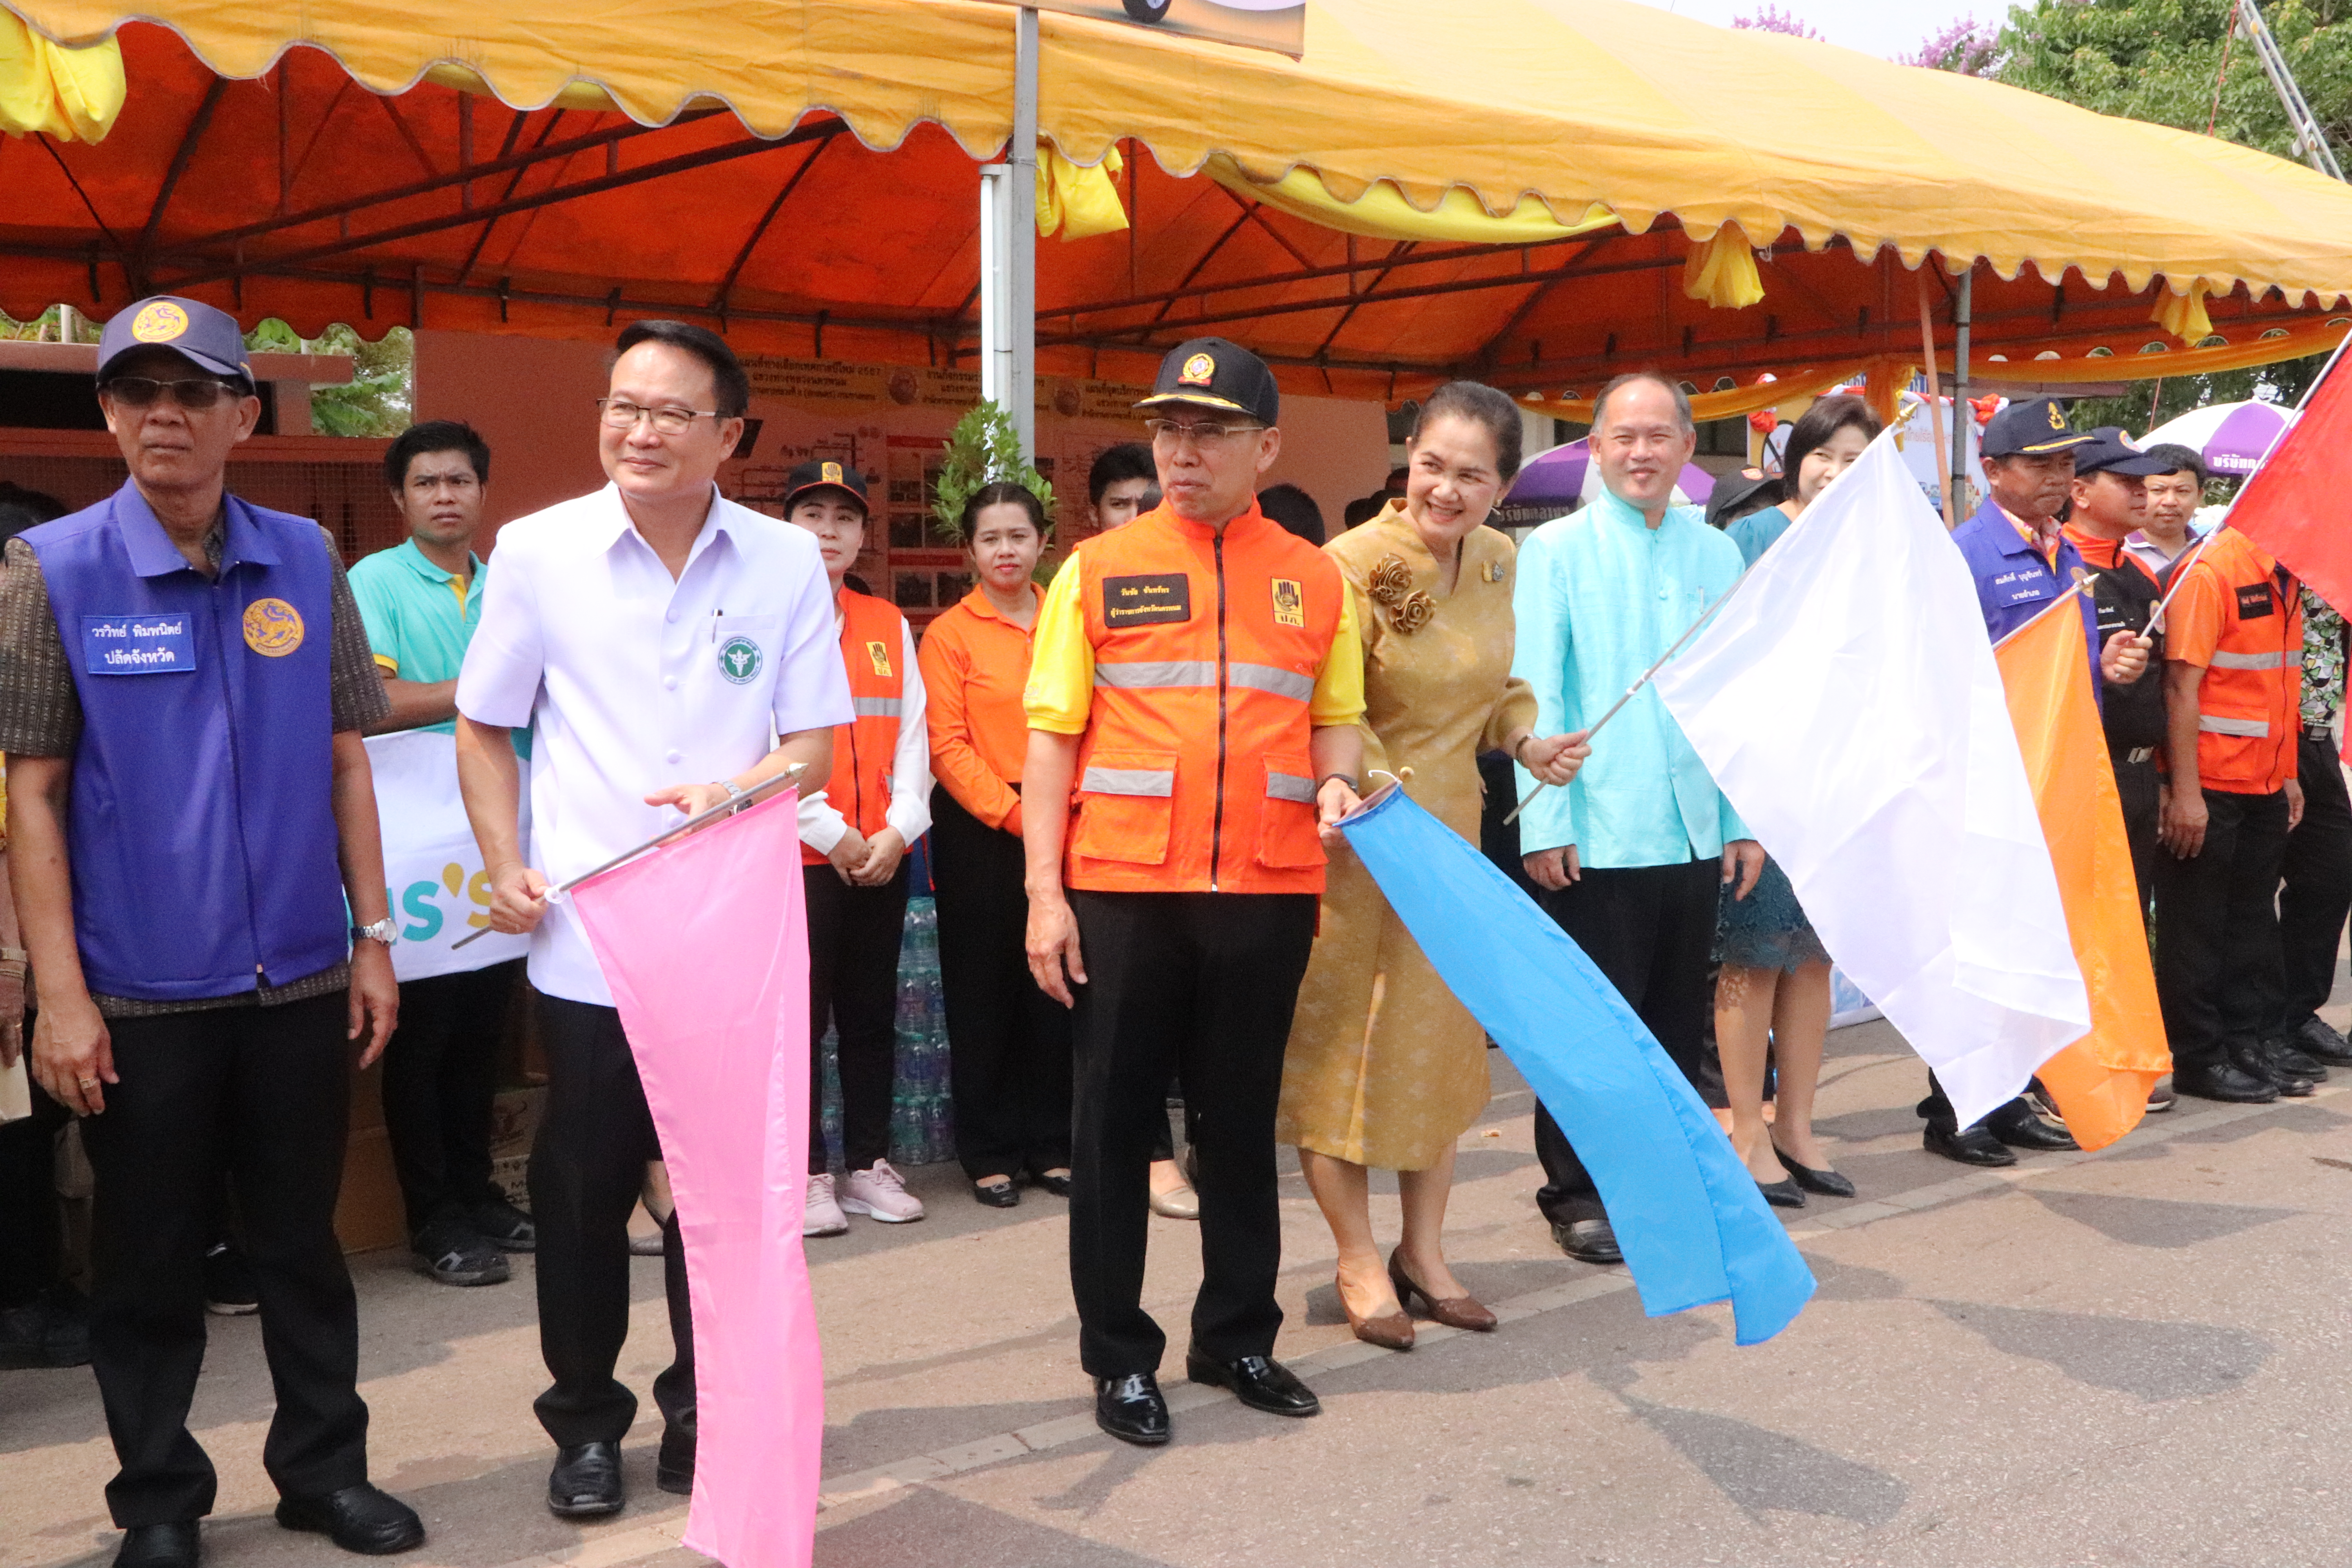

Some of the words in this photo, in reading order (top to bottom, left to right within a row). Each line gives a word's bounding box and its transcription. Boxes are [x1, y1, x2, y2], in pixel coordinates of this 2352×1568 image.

[2213, 454, 2268, 470] บริษัทก
[1121, 587, 1138, 596] วันชัย
[92, 624, 127, 638] วรวิทย์
[104, 646, 175, 664] ปลัดจังหวัด
